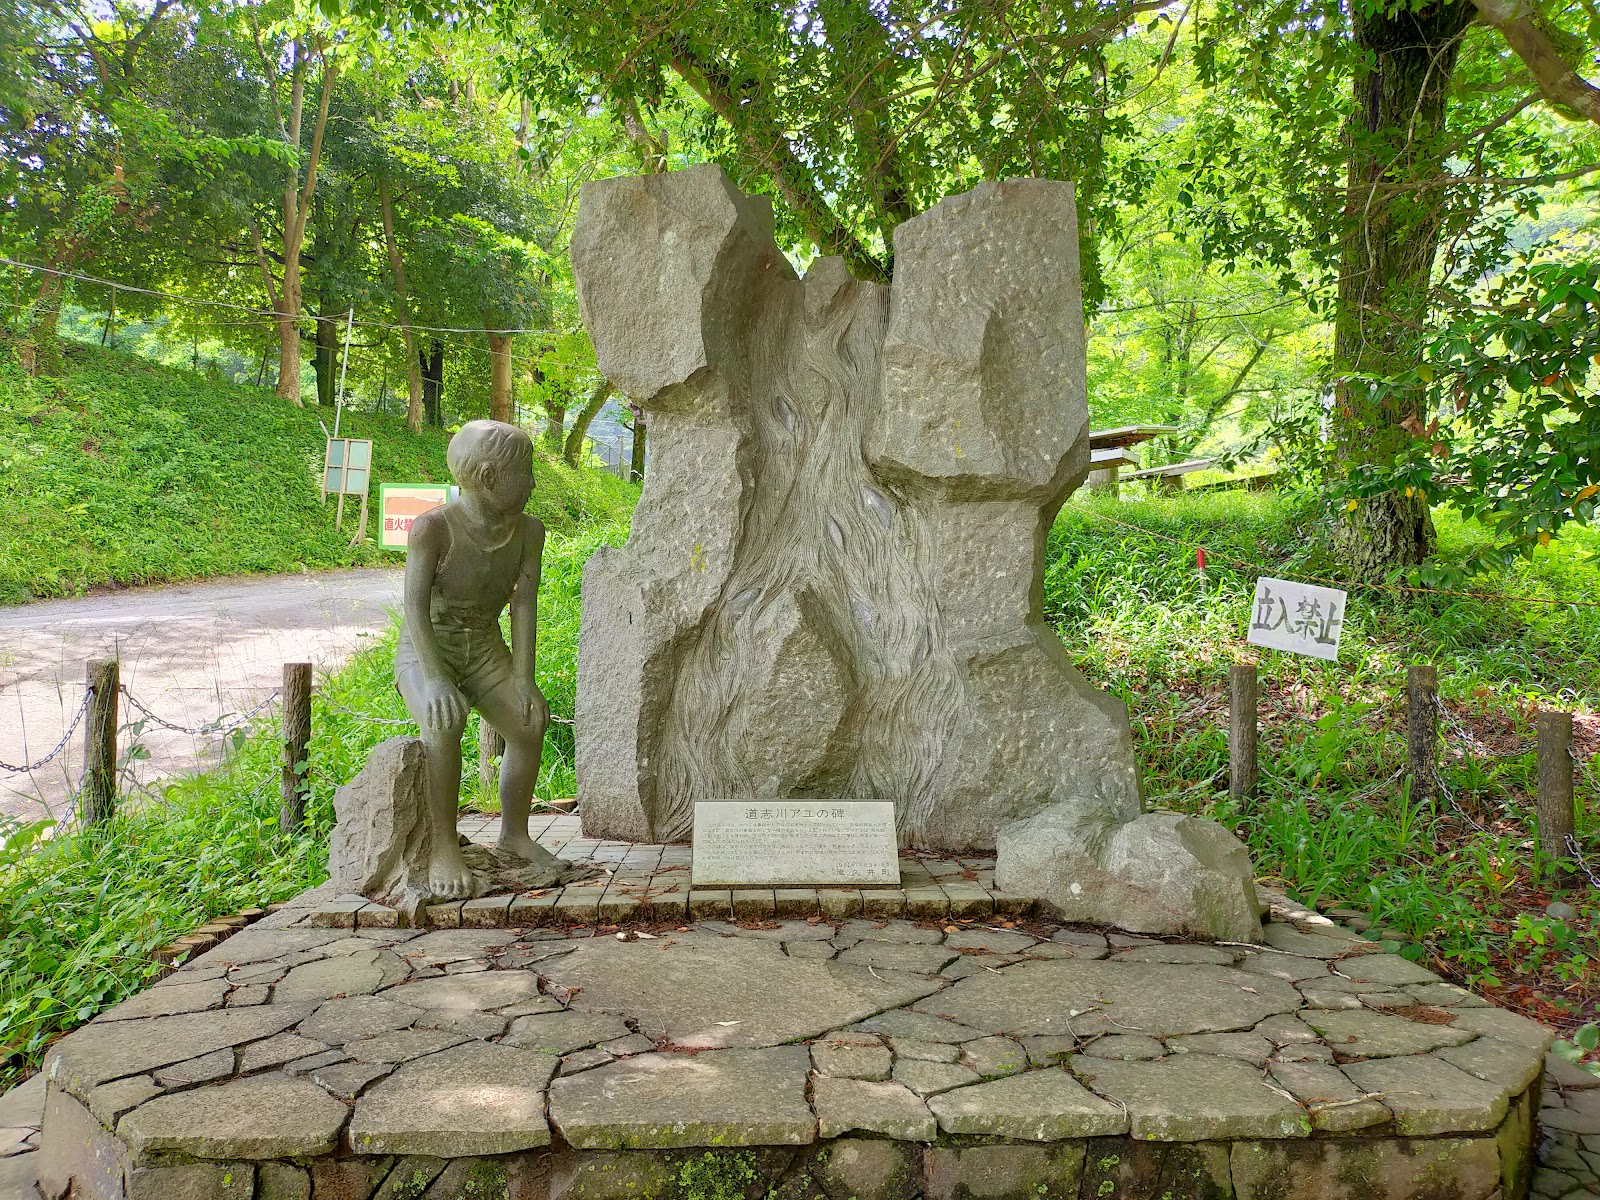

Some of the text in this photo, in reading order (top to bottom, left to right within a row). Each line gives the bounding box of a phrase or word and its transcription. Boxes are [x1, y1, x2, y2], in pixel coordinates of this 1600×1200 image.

[1252, 587, 1340, 645] 立入禁止
[745, 808, 845, 820] 道志川アユの碑
